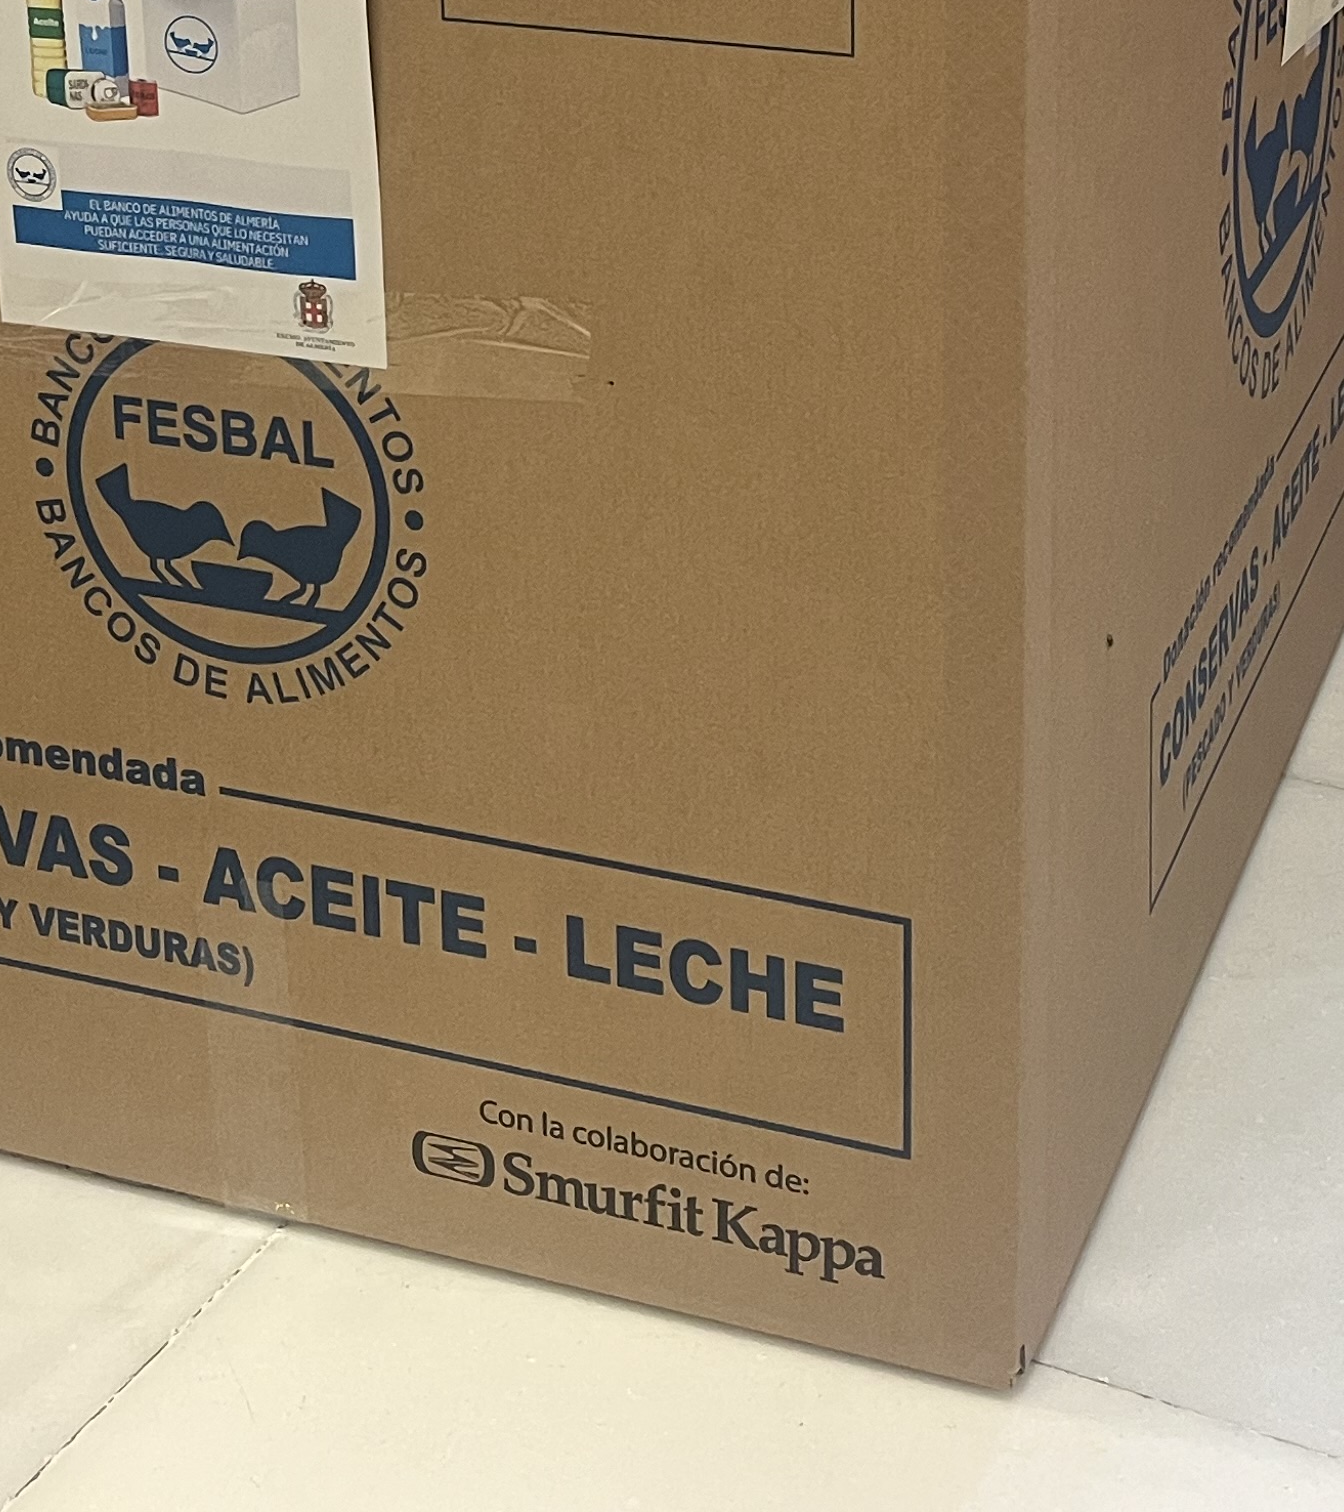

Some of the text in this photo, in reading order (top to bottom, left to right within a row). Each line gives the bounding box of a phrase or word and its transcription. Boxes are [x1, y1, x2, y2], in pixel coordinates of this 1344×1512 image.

[64, 210, 309, 246] AYUDA A QUE LAS PERSONAS QUE LO NECESITAN
[84, 224, 289, 258] PUEDAN ACCEDER A UNA ALIMENTACIÓN
[88, 198, 281, 230] EL BANCO DE ALIMENTOS DE ALMERÍA
[164, 244, 206, 260] SEGURA
[207, 251, 216, 261] Y
[1219, 204, 1259, 398] BANCOS
[1260, 340, 1281, 400] DE
[113, 394, 335, 468] FESBAL
[36, 499, 427, 705] BANCOS DE ALIMENTOS
[1159, 546, 1259, 787] CONSERVAS
[1271, 425, 1322, 565] ACEITE
[1182, 691, 1226, 812] (PESCADO
[1227, 673, 1235, 707] Y
[29, 903, 255, 988] VERDURAS)
[158, 864, 179, 883] -
[203, 845, 488, 960] ACEITE
[514, 937, 537, 955] -
[565, 914, 846, 1034] LECHE
[478, 1099, 810, 1195] Con la colaboración de:
[502, 1150, 886, 1285] Smurfit Kappa
